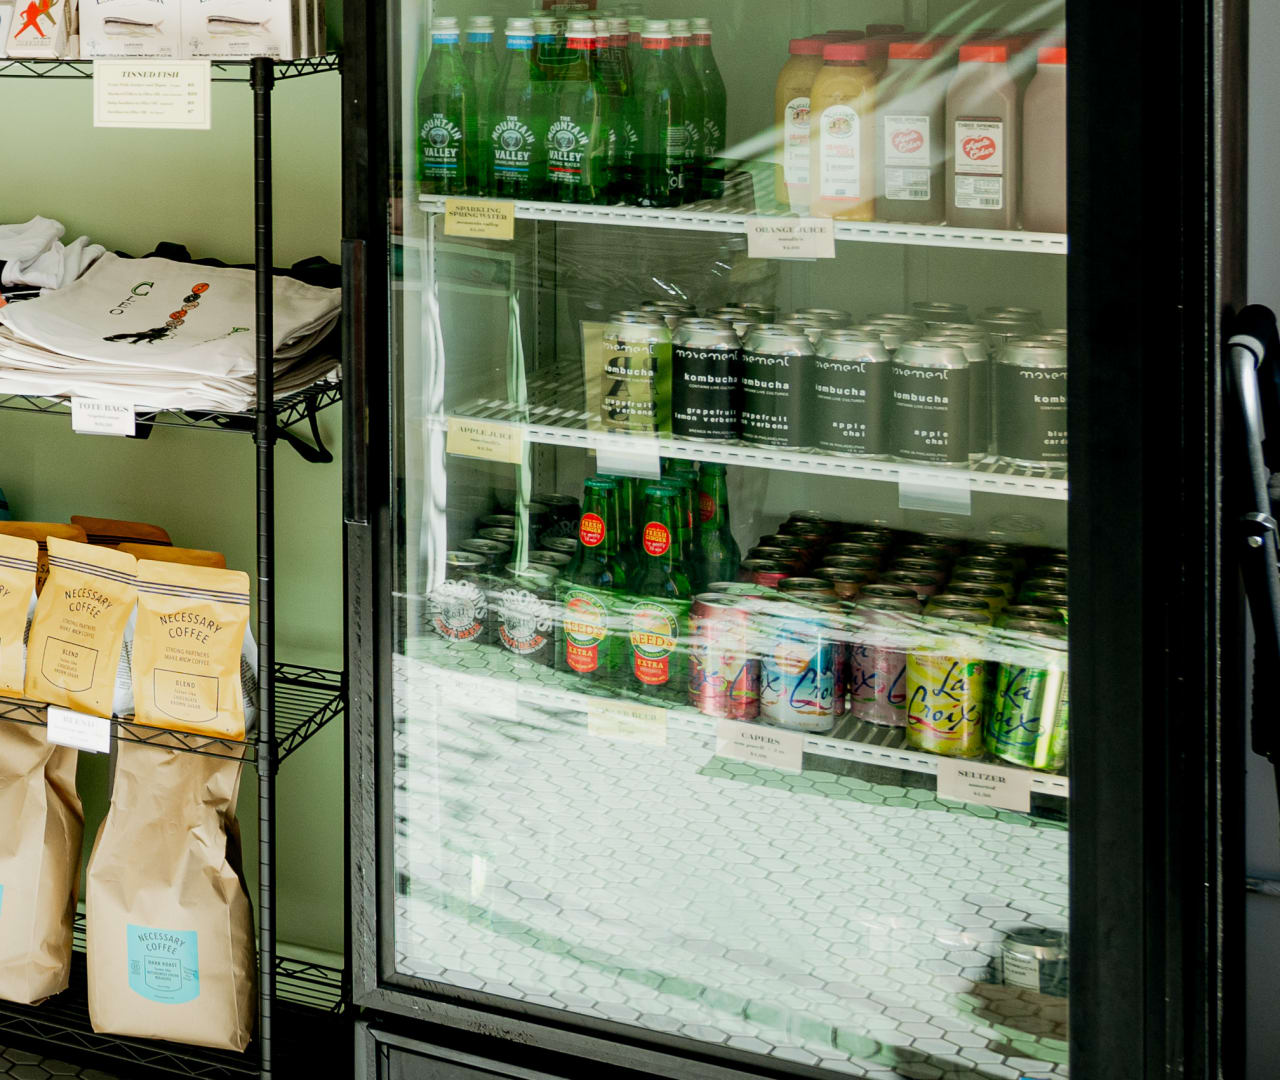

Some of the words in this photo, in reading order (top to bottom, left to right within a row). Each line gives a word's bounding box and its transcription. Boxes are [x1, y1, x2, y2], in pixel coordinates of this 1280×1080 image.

[491, 121, 535, 144] MOUNTAIN
[494, 150, 529, 161] VALLEY
[159, 612, 223, 634] NECESSARY
[168, 627, 209, 645] COFFEE
[632, 632, 674, 648] REED'S
[637, 658, 664, 669] EXTRA
[176, 680, 195, 689] BLEND
[931, 661, 968, 701] La
[958, 769, 1006, 783] SELTZER
[138, 932, 186, 948] NECESSARY
[145, 943, 178, 955] COFFEE
